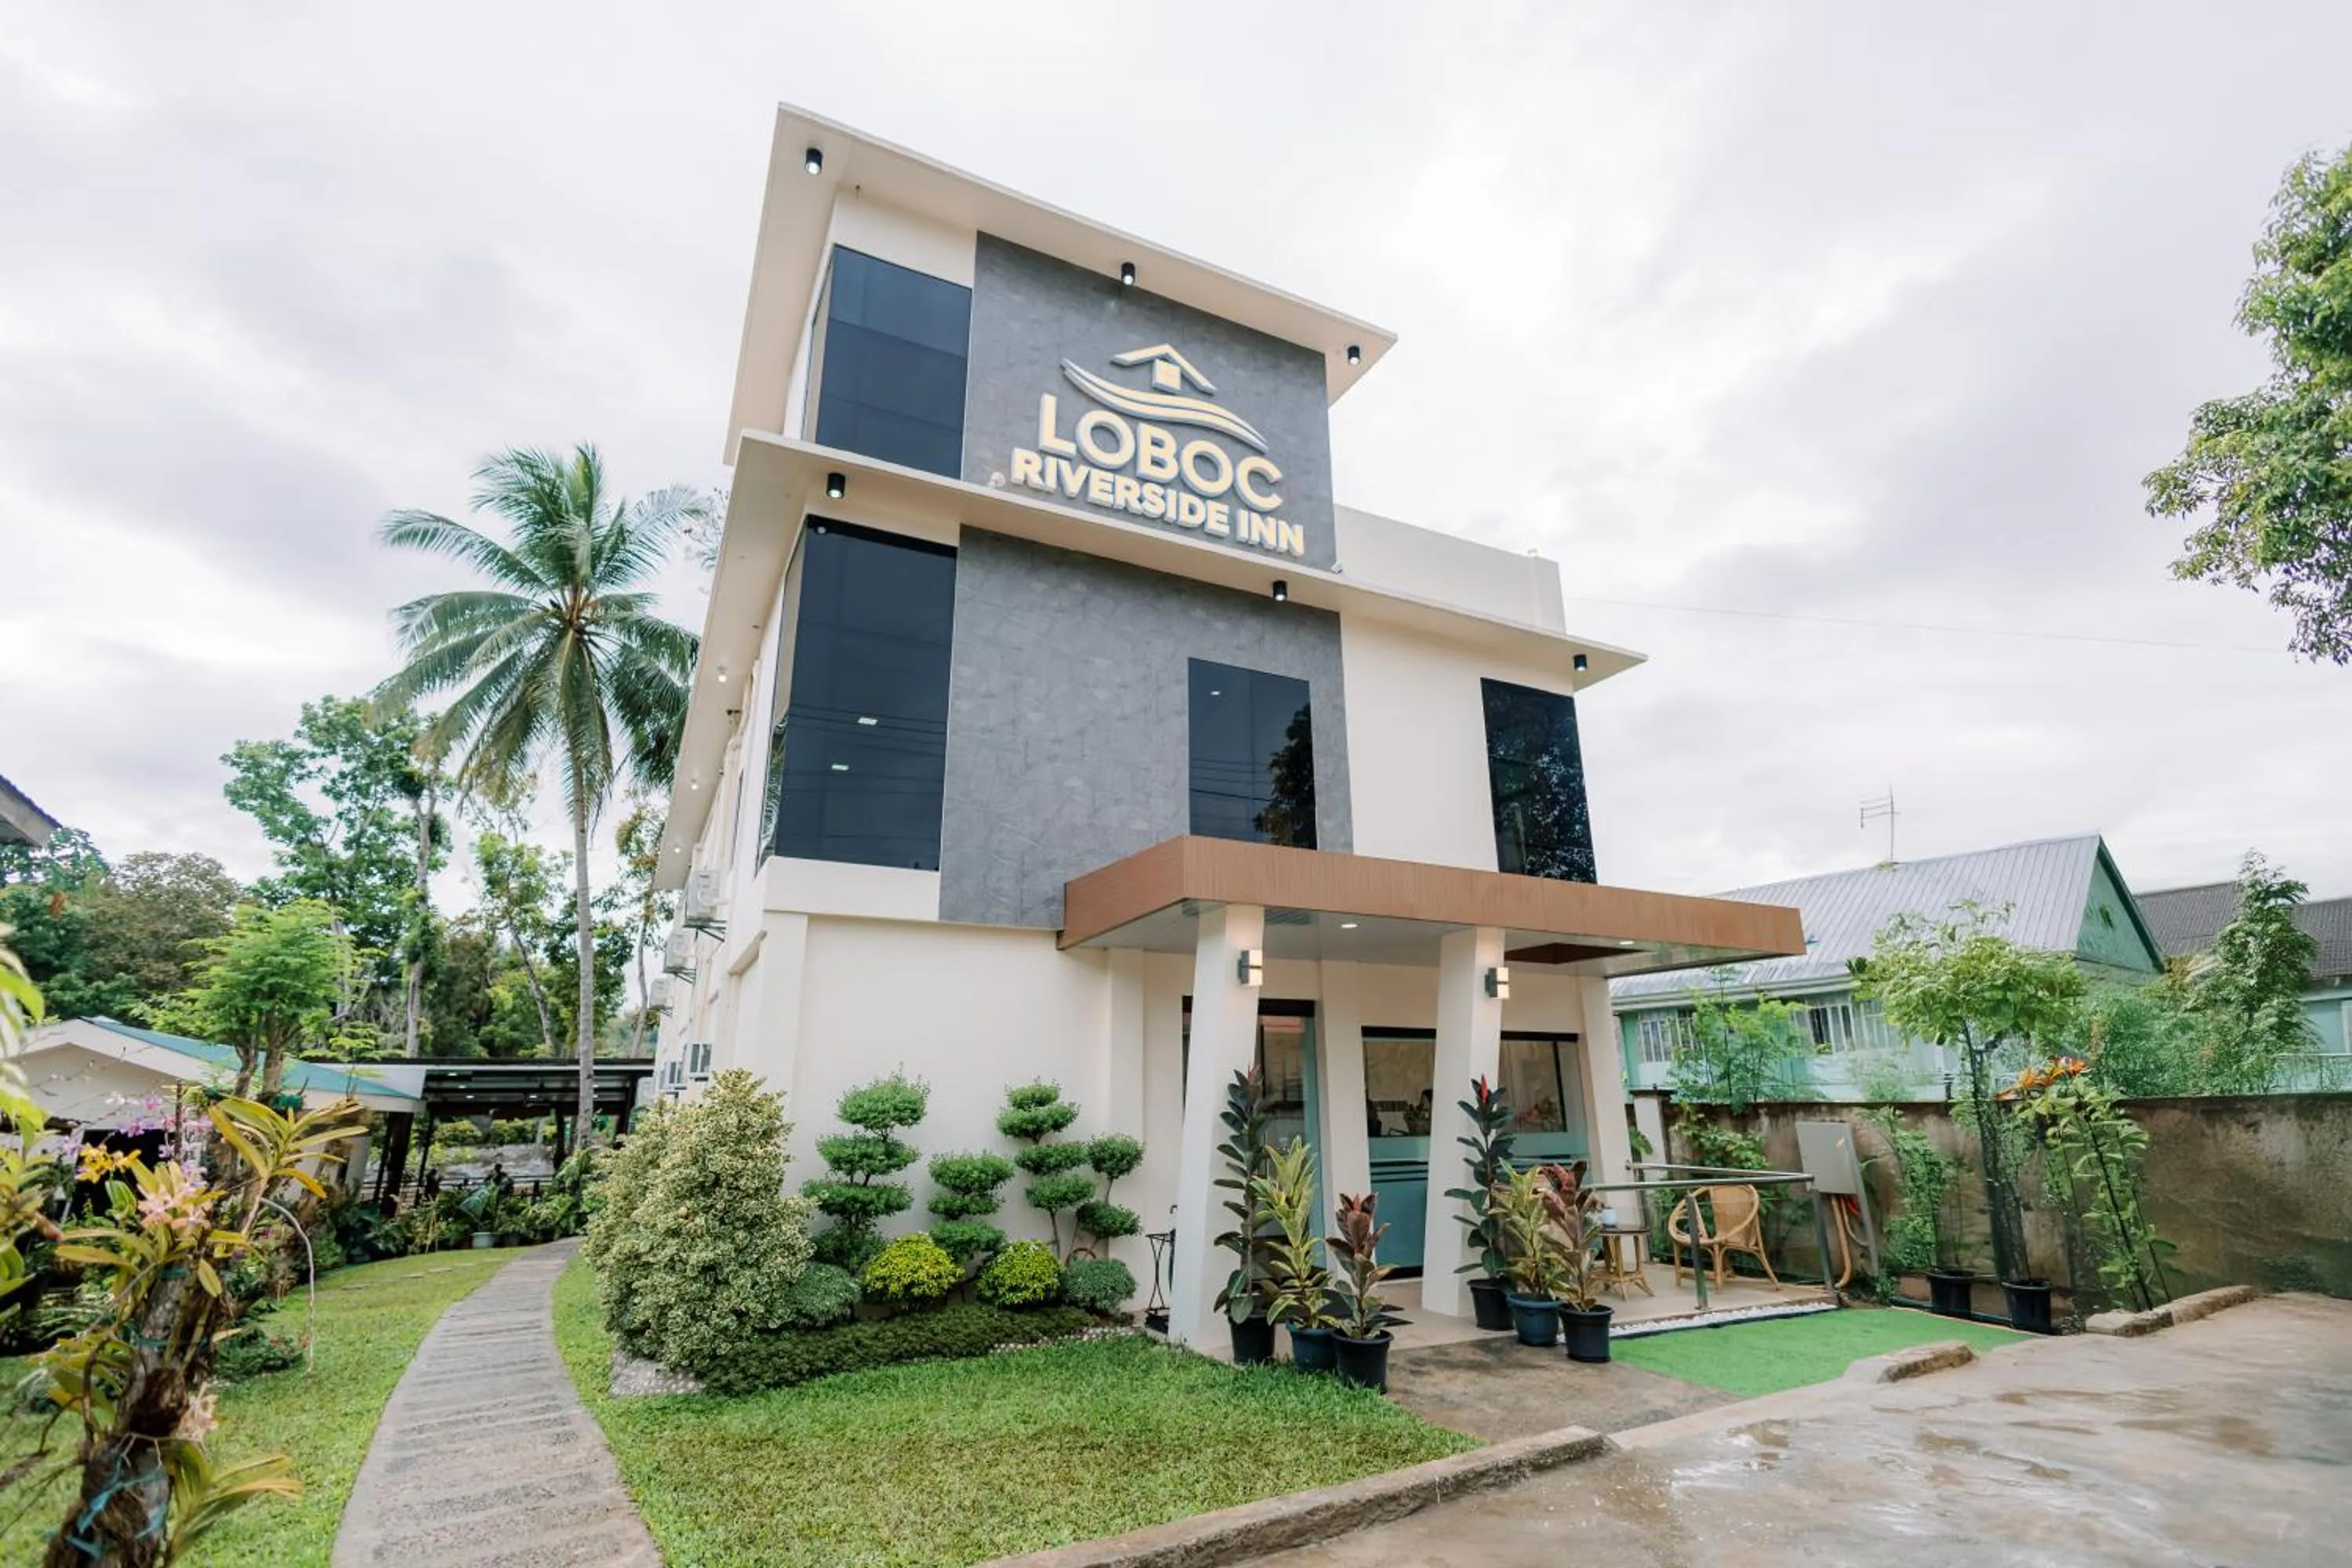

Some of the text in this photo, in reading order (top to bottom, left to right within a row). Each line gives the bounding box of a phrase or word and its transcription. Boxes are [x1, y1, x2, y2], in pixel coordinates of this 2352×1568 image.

[1011, 447, 1305, 557] RIVERSIDE INN
[1039, 393, 1283, 513] LOBOC
